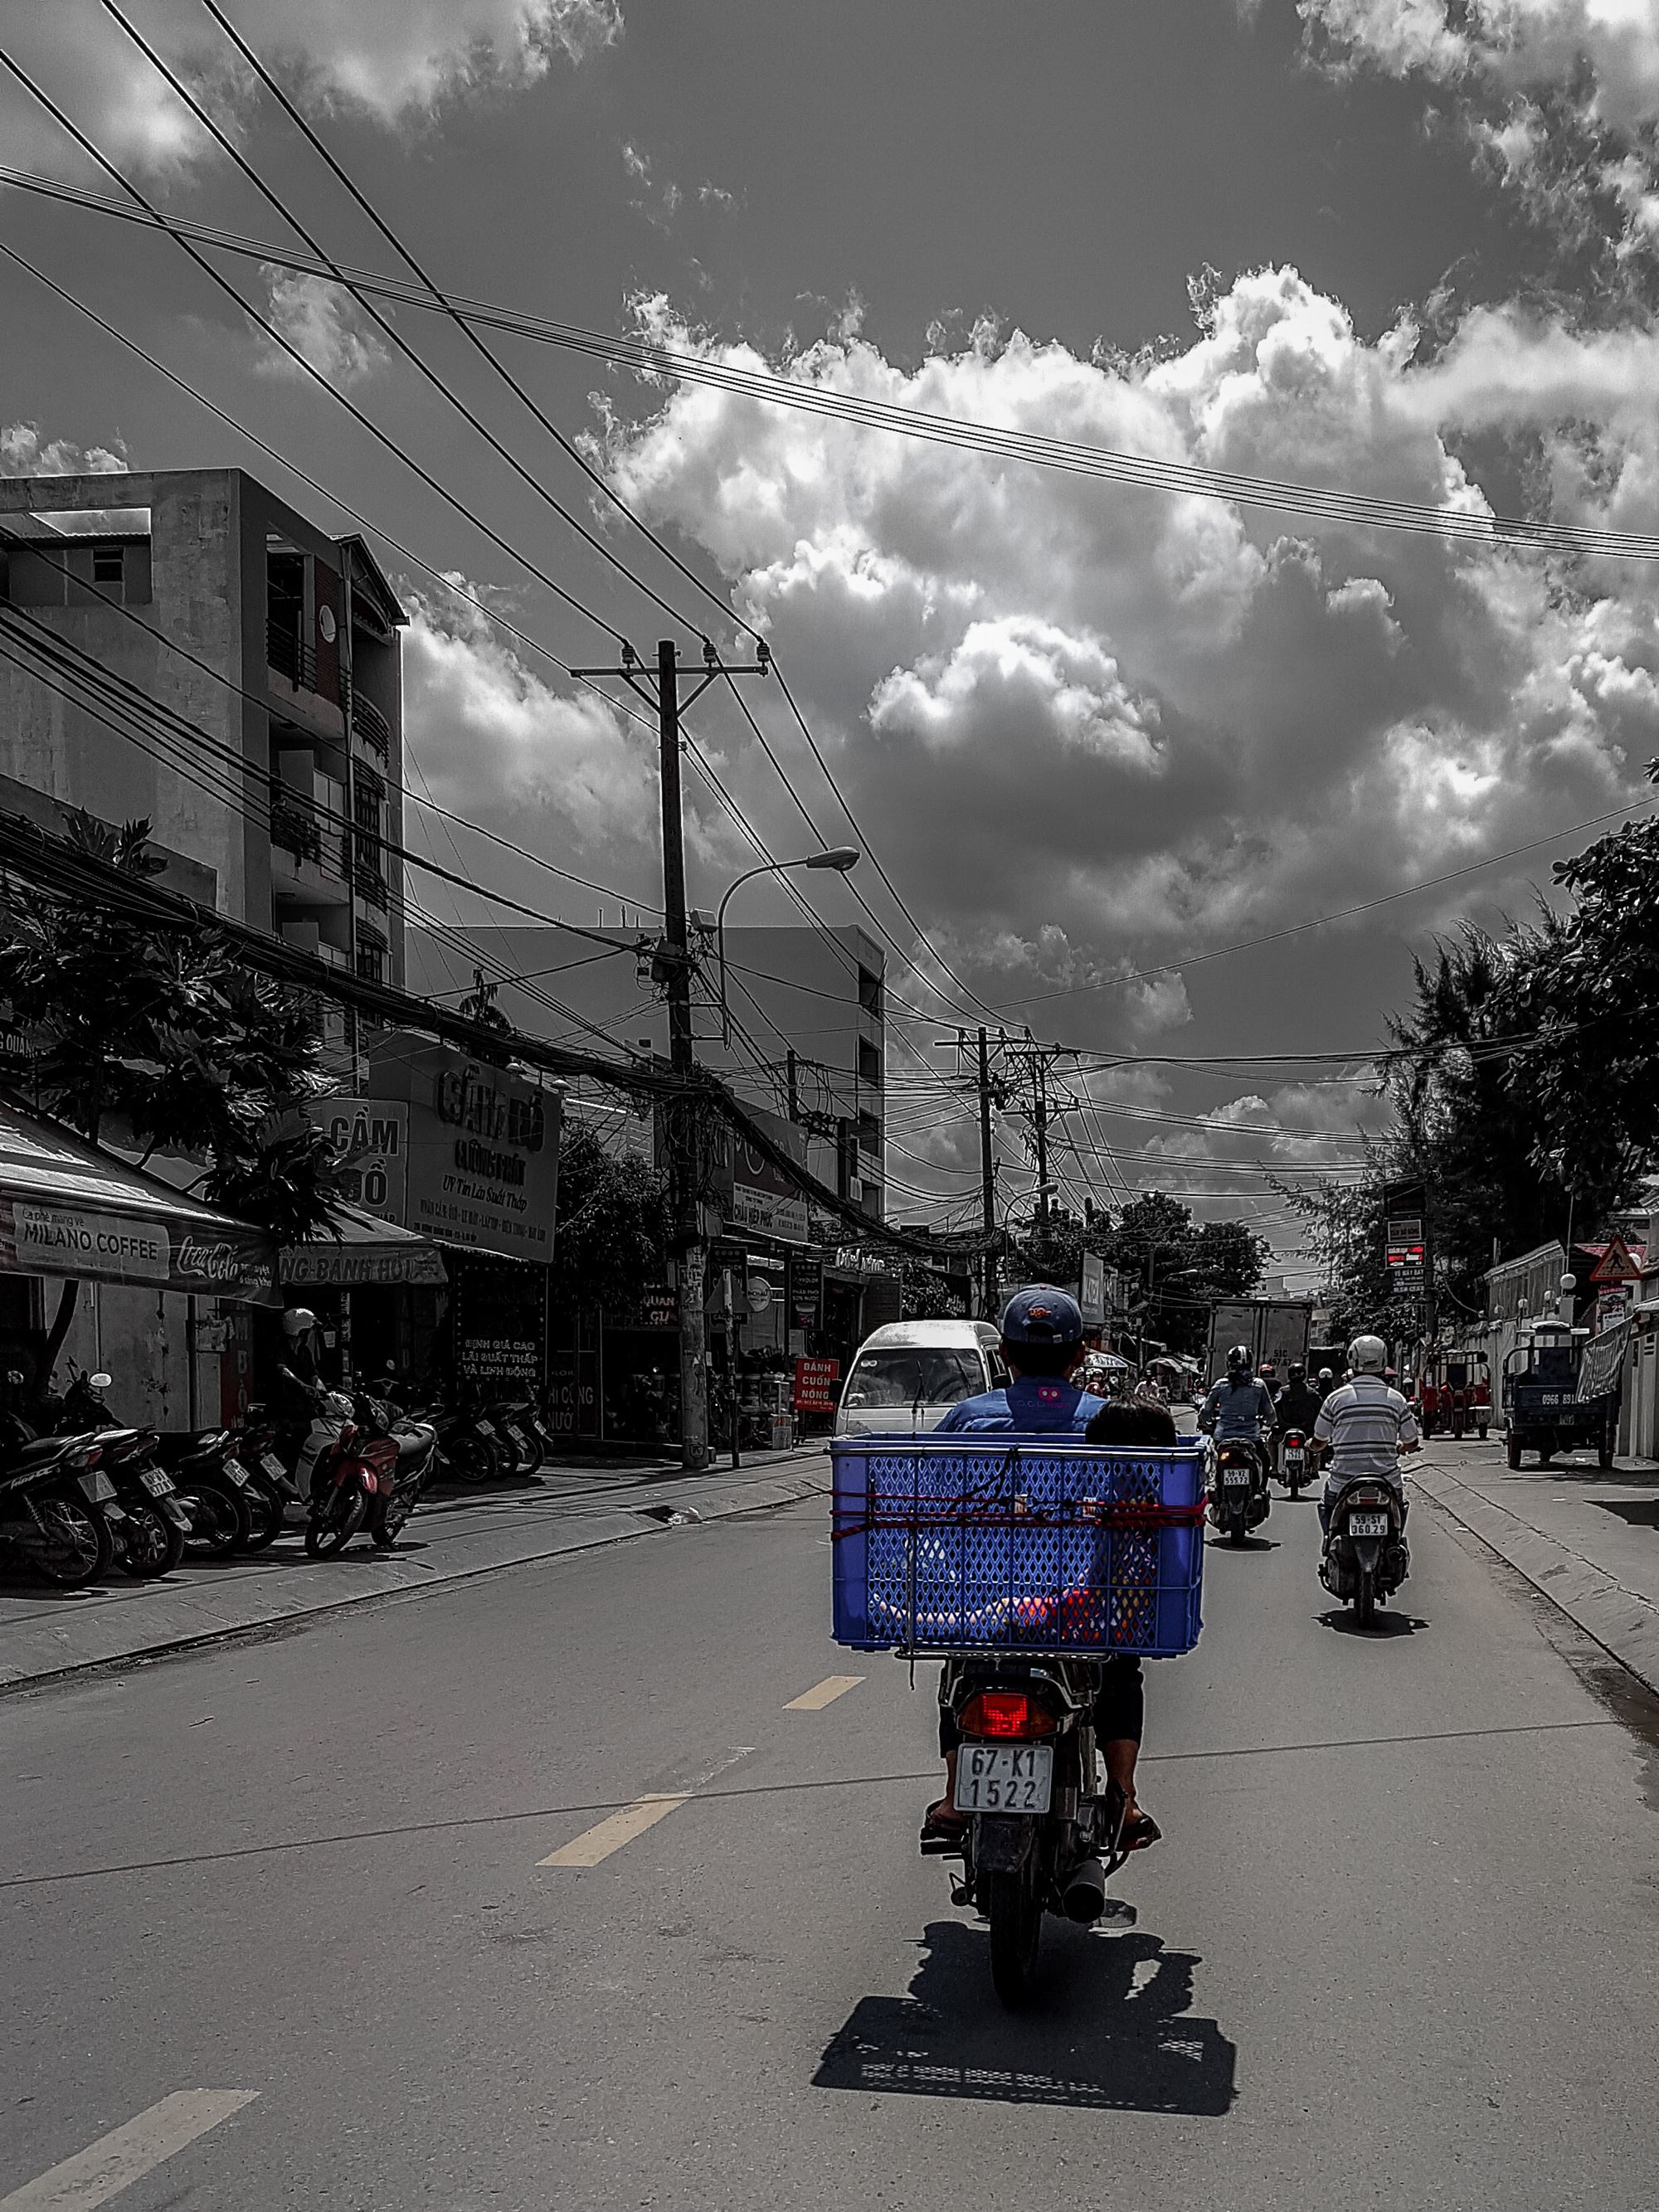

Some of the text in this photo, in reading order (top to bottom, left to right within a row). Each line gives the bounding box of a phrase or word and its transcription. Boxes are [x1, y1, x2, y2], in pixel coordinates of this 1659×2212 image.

[330, 1105, 399, 1155] CẦM
[24, 1223, 158, 1261] MILANO COFFEE
[513, 1341, 536, 1351] CAO
[463, 1364, 478, 1375] VÀ
[803, 1361, 831, 1373] BÁNH
[802, 1373, 830, 1386] CUỐN
[800, 1388, 830, 1400] NÓNG
[1542, 1394, 1559, 1405] 0966
[1355, 1514, 1380, 1524] 59-S1
[971, 1749, 1035, 1777] 67-K1
[971, 1779, 1036, 1808] 1522
